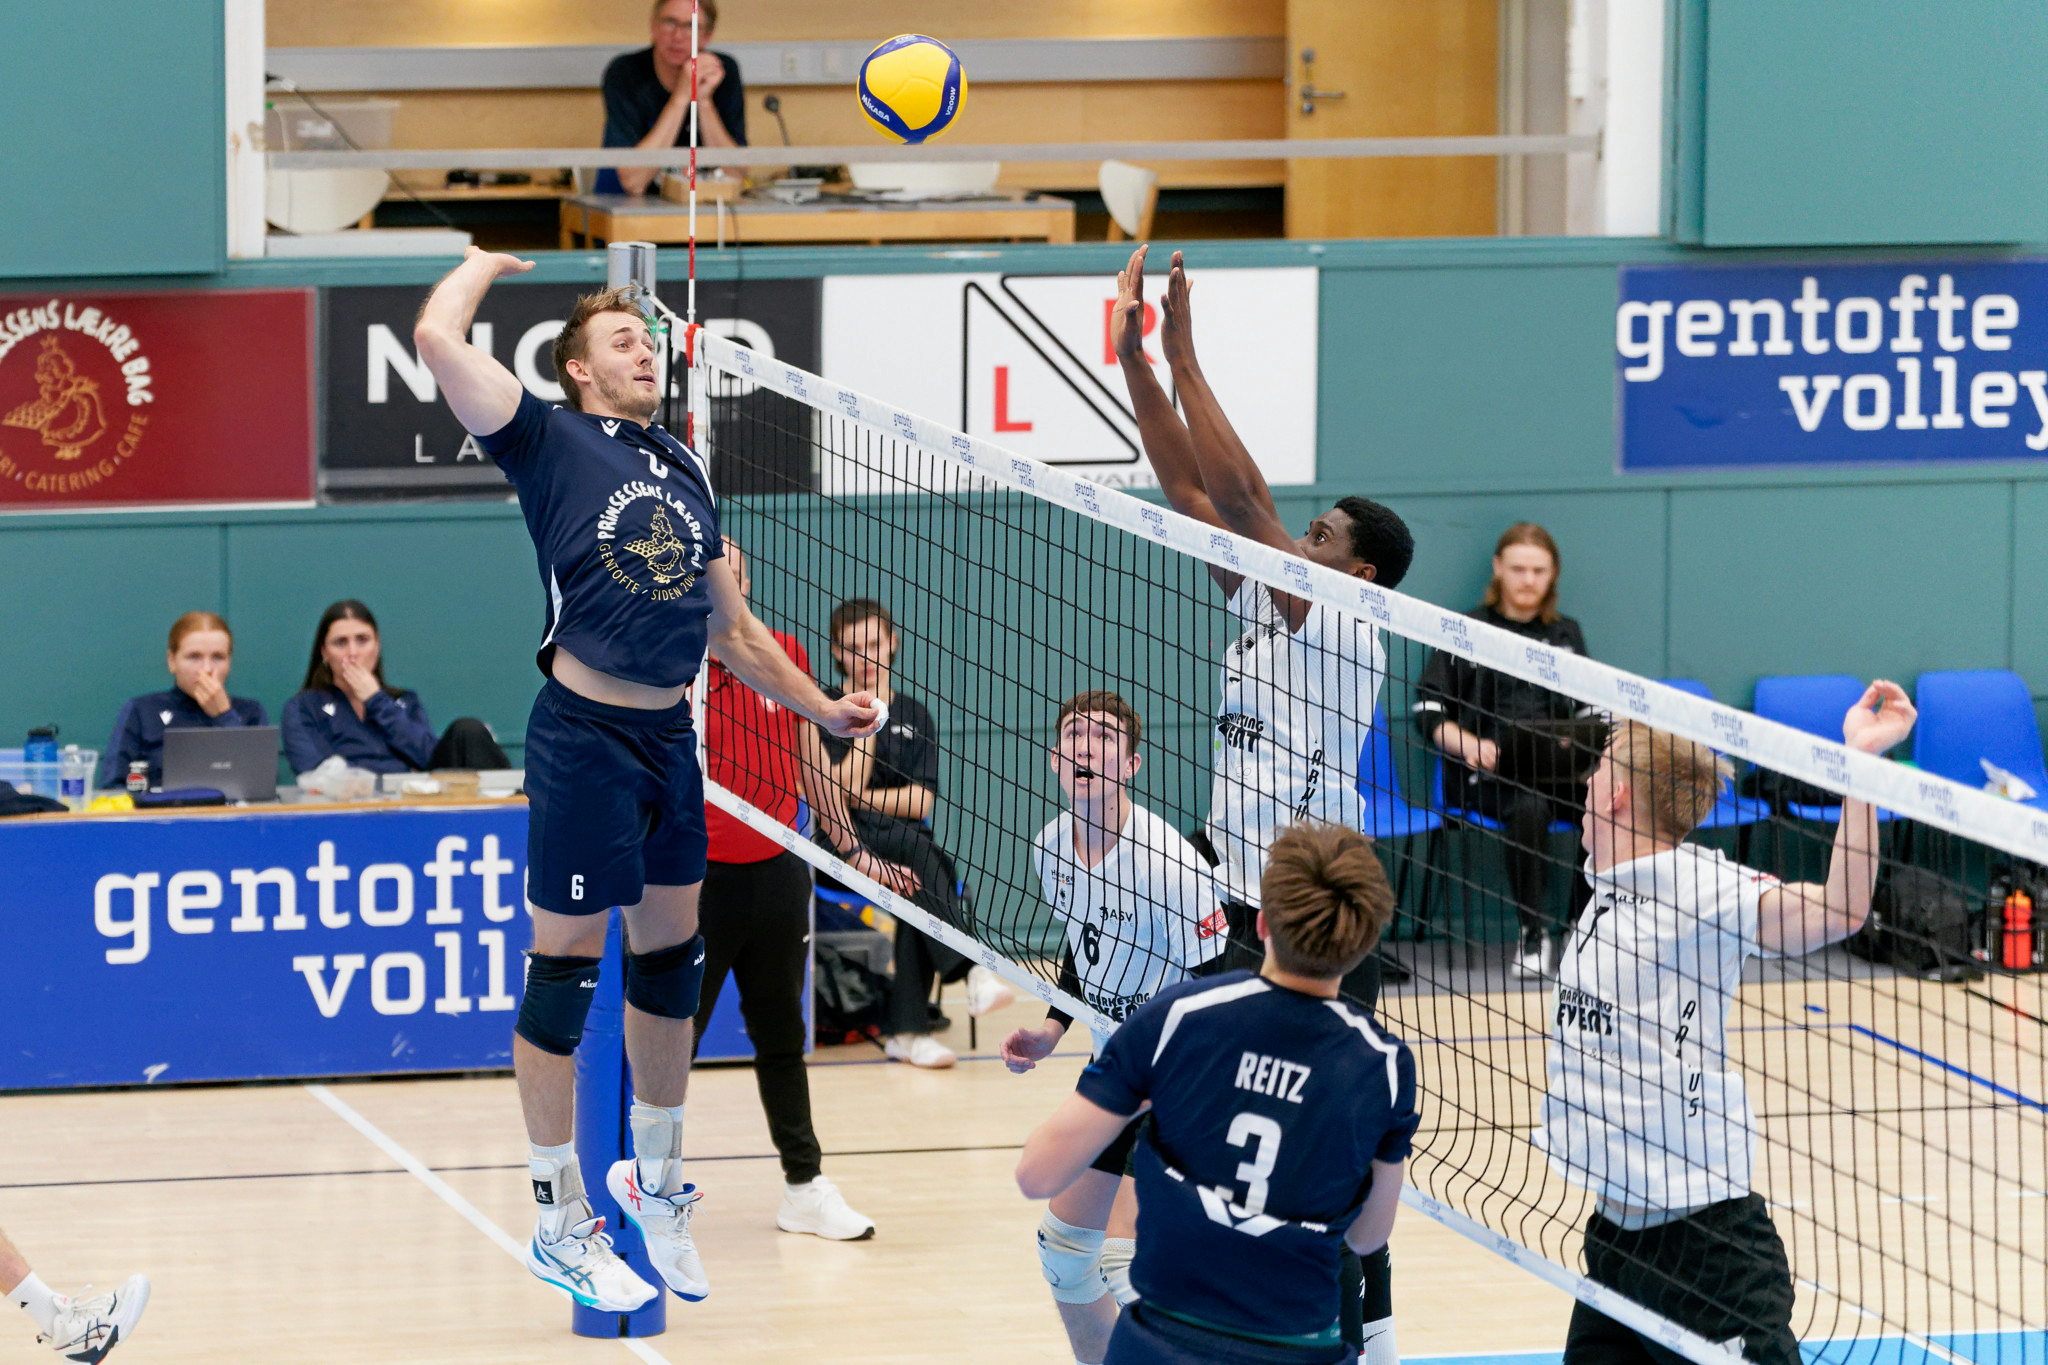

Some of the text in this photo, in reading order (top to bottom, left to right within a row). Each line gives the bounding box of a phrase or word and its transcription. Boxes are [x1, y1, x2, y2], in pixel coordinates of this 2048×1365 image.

[945, 86, 957, 116] V200W
[64, 302, 139, 363] LÆKRE
[1104, 299, 1157, 365] R
[1616, 274, 2020, 382] gentofte
[994, 366, 1033, 432] L
[25, 458, 114, 493] CATERING
[116, 413, 148, 458] CAFE
[597, 480, 663, 540] PRINSESSENS
[599, 543, 640, 595] GENTOFTE
[651, 586, 683, 601] SIDEN
[94, 834, 532, 965] gentoft
[571, 874, 584, 900] 6
[292, 929, 530, 1019] voll
[1083, 922, 1100, 967] 6
[1234, 1051, 1311, 1104] REITZ
[1225, 1111, 1282, 1218] 3
